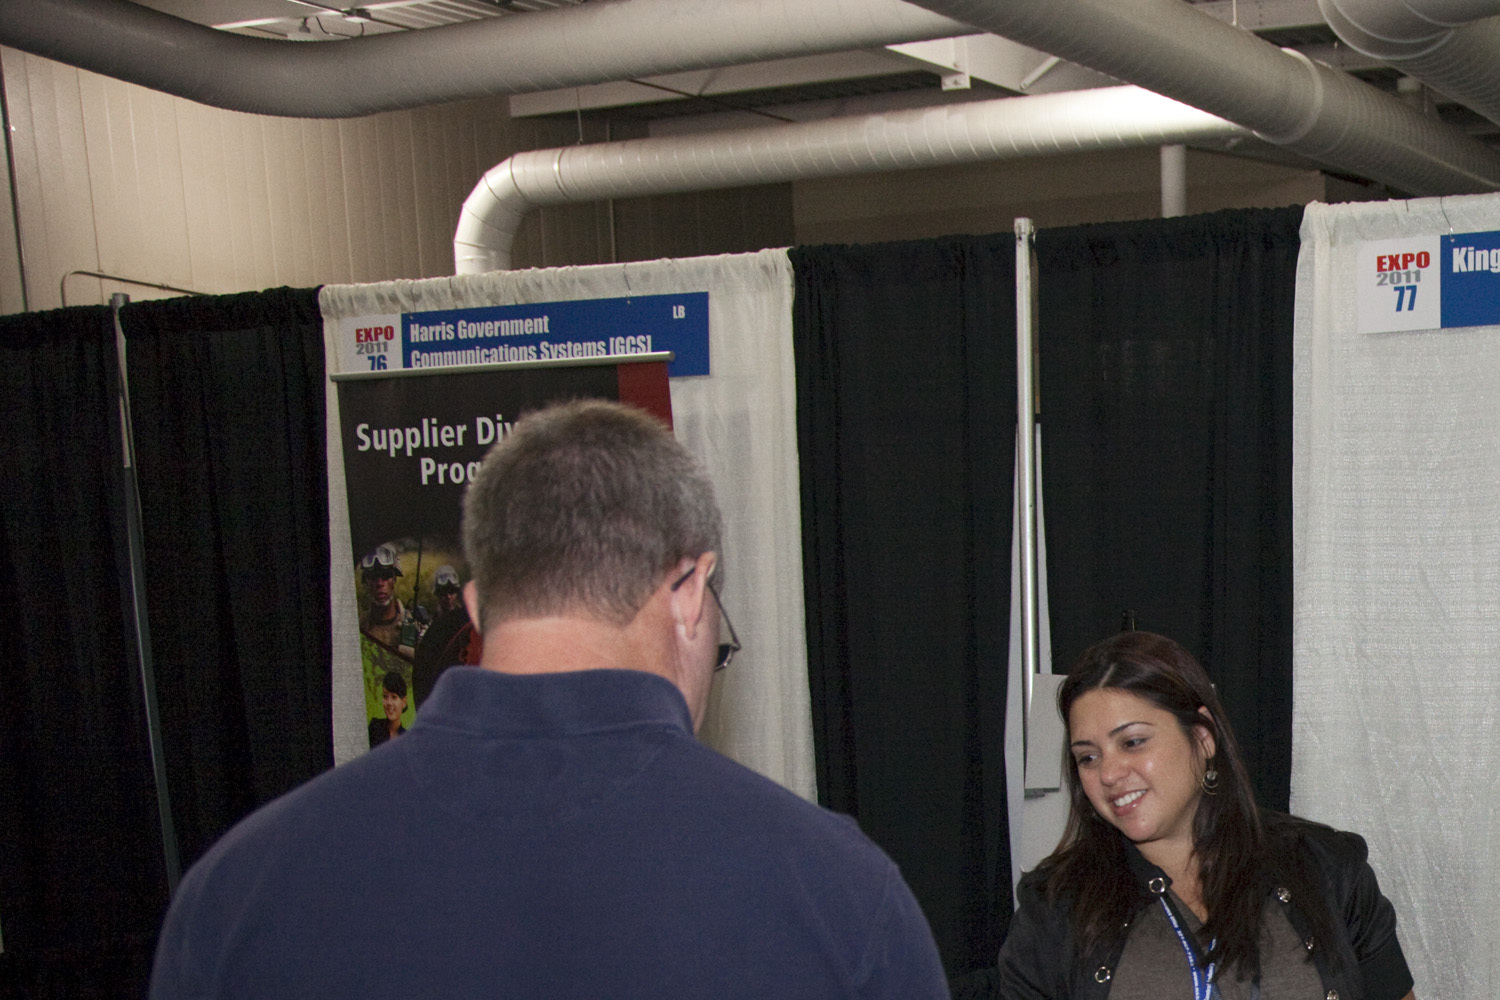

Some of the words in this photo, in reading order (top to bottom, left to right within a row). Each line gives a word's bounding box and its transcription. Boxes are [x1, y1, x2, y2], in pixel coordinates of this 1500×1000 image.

[1376, 251, 1430, 273] EXPO
[1376, 269, 1422, 286] 2011
[1393, 285, 1417, 312] 77
[672, 305, 686, 319] LB
[355, 325, 394, 343] EXPO
[410, 322, 454, 342] Harris
[458, 315, 549, 339] Government
[356, 341, 388, 355] 2011
[411, 344, 537, 368] Communications
[540, 340, 607, 360] Systems
[368, 354, 387, 371] 76
[356, 417, 467, 457] Supplier
